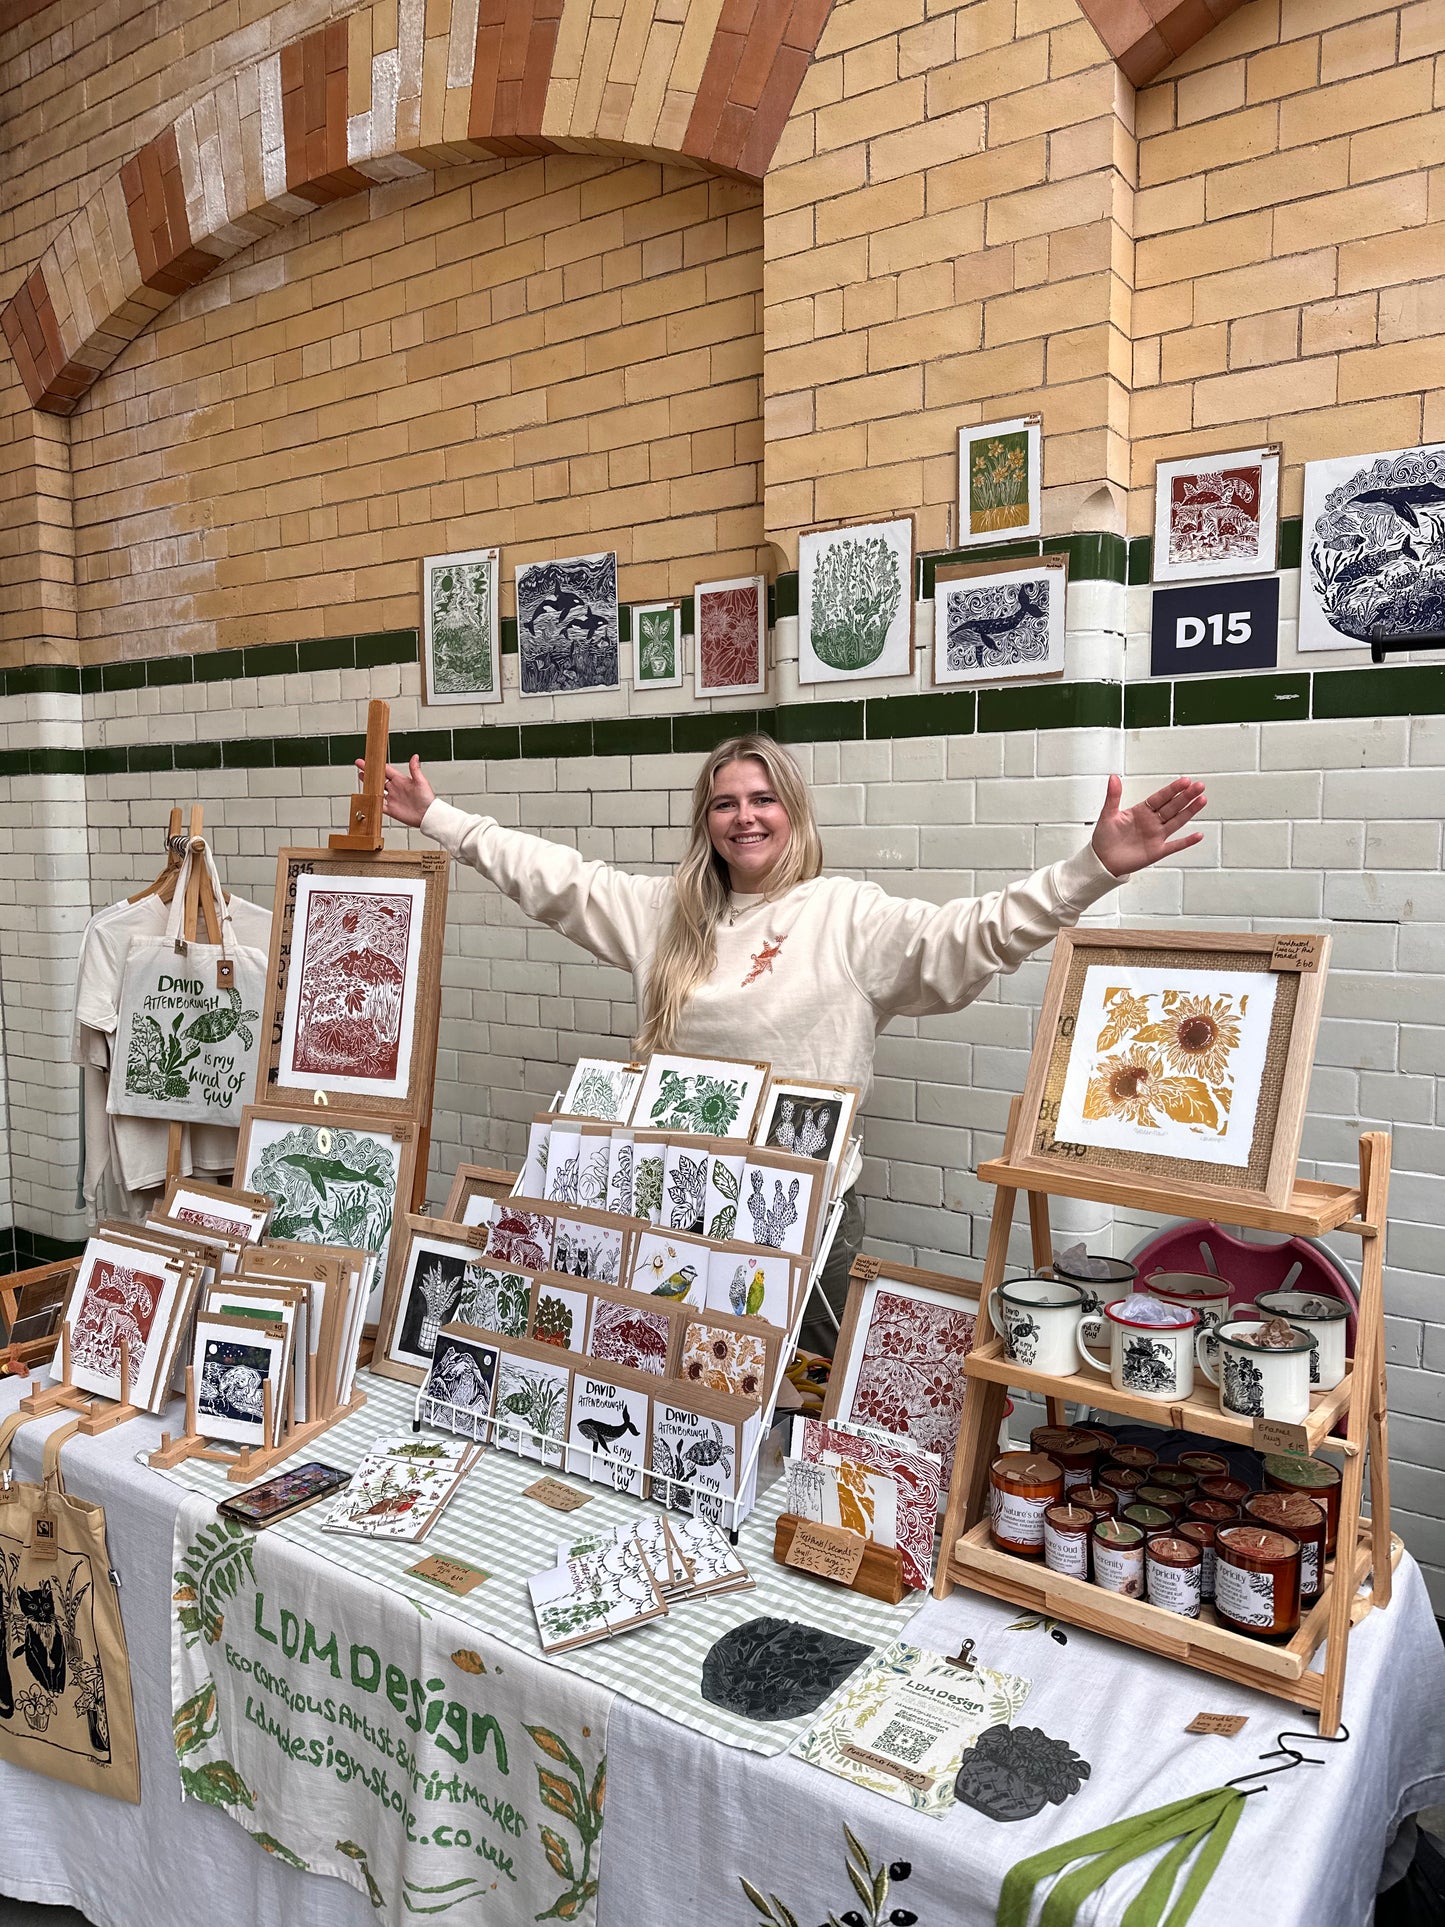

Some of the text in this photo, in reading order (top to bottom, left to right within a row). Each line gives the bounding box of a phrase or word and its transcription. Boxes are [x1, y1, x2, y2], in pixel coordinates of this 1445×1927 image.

[1176, 611, 1252, 649] D15
[158, 975, 204, 996] DAVID
[143, 995, 219, 1011] ATTENBOROUGH
[204, 1051, 235, 1074] is my
[188, 1066, 221, 1089] kind
[585, 1381, 616, 1398] DAVID
[578, 1395, 625, 1411] ATTENBOROUGH
[666, 1407, 699, 1427] DAVID
[658, 1422, 709, 1440] ATTENBOROUGH
[613, 1444, 632, 1463] is my
[1288, 1442, 1304, 1452] £15
[706, 1478, 720, 1493] my
[1004, 1506, 1032, 1518] Nature's
[1063, 1545, 1077, 1553] Oud
[800, 1556, 813, 1565] £3
[833, 1566, 846, 1576] £5
[1152, 1566, 1182, 1582] Apricity
[1220, 1564, 1247, 1584] Apricity
[254, 1592, 509, 1775] LDM Design
[905, 1680, 985, 1713] LDM Design
[339, 1703, 396, 1758] Artist
